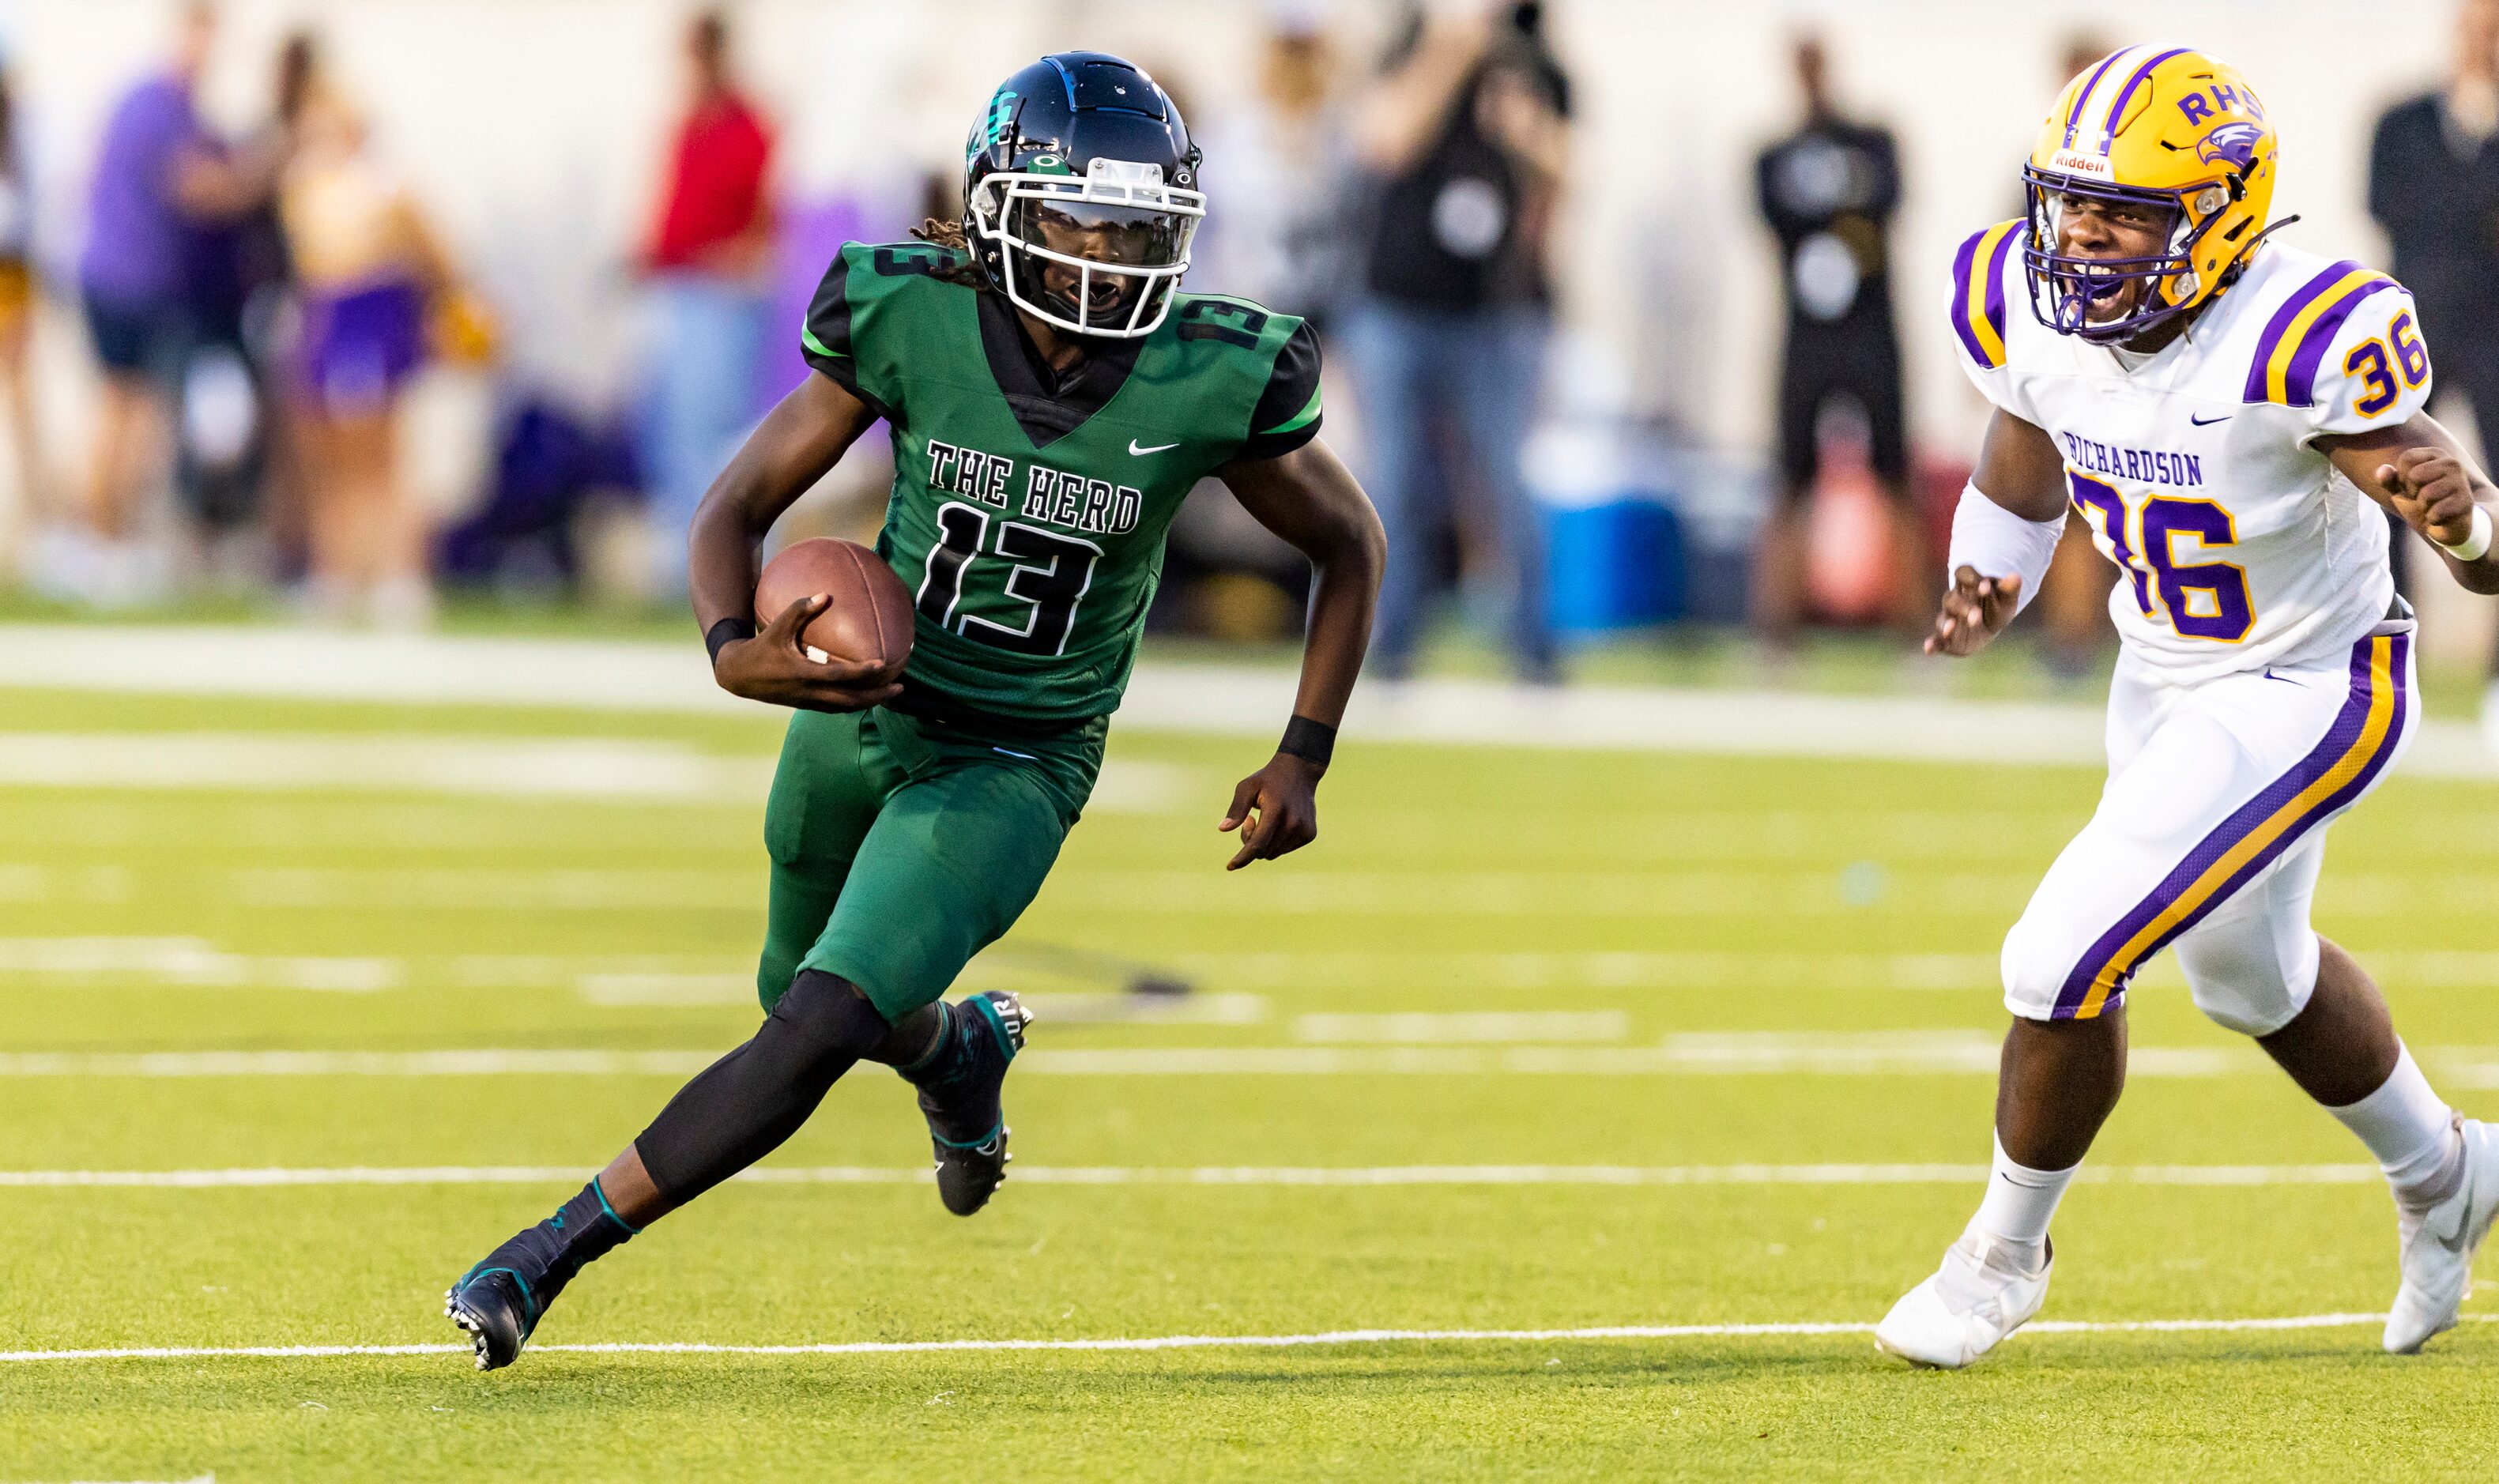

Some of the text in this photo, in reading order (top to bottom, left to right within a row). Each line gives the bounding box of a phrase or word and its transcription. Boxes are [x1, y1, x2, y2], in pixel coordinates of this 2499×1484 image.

[2177, 85, 2263, 127] RHS
[2056, 153, 2105, 173] Riddell
[1176, 299, 1269, 351] 13
[2342, 308, 2429, 420] 36
[927, 439, 1142, 535] THE HERD
[2063, 431, 2203, 486] RICHARDSON
[915, 501, 1105, 657] 13
[2066, 466, 2257, 644] 36
